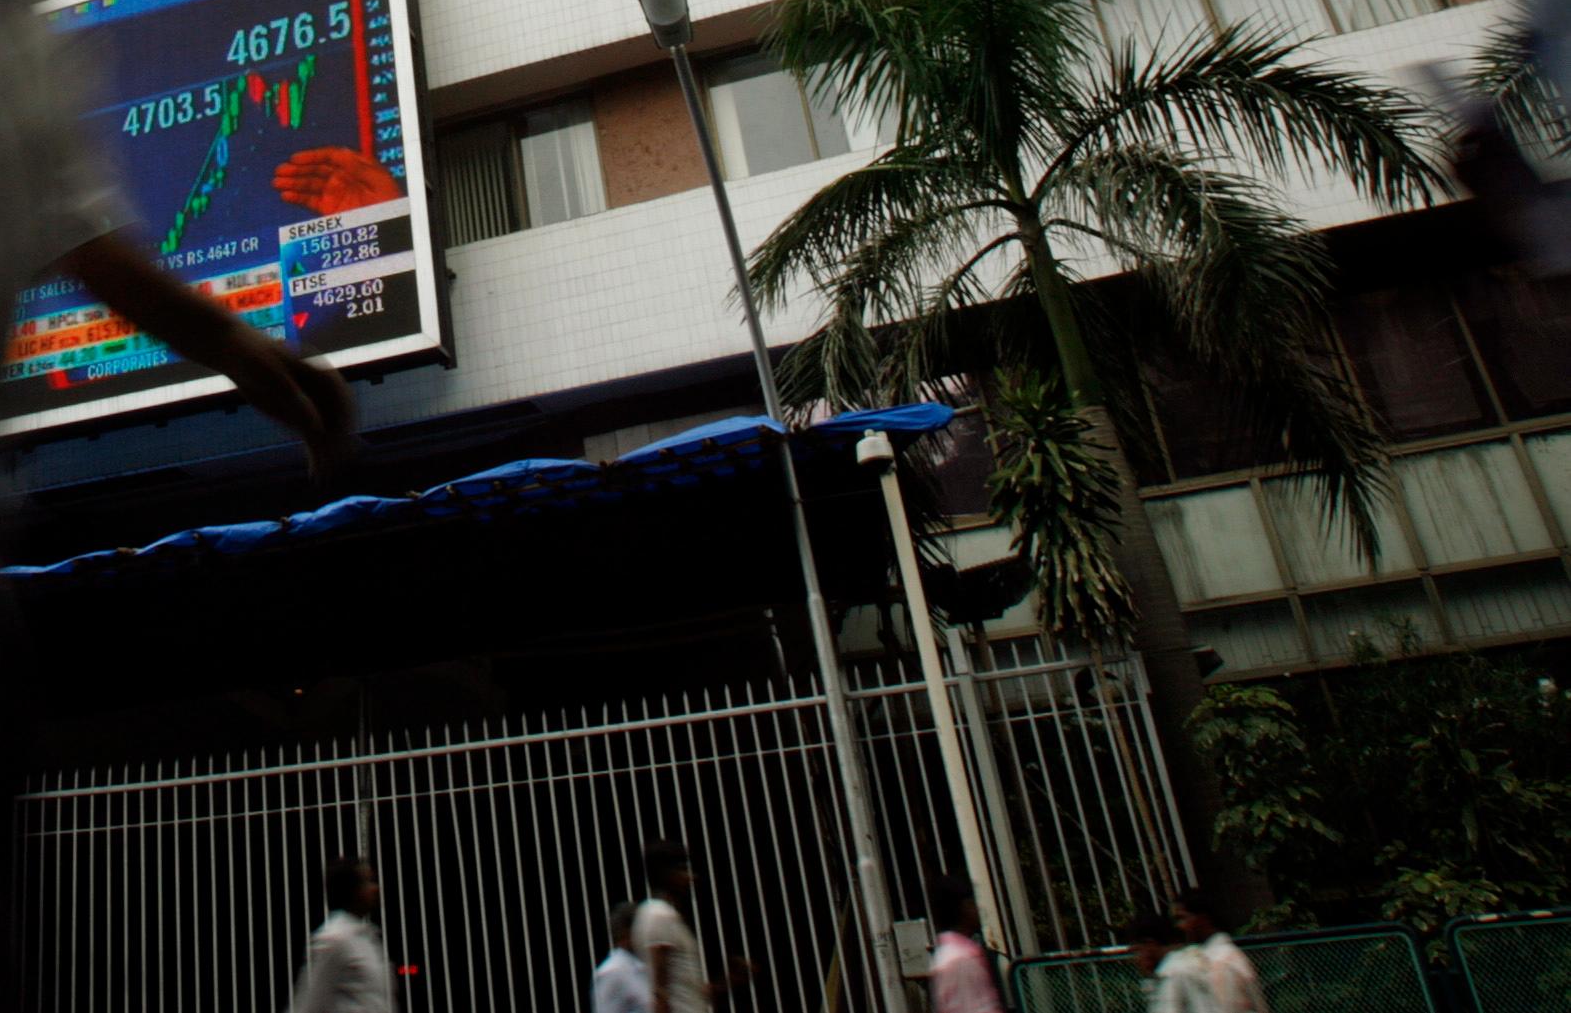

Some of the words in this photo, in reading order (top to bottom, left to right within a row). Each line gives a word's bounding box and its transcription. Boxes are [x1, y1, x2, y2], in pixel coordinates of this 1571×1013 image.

[226, 0, 351, 66] 4676.5
[122, 83, 223, 137] 4703.5
[288, 216, 343, 239] SENSEX
[301, 224, 379, 255] 15610.82
[168, 254, 183, 269] VS
[241, 236, 259, 254] CR
[321, 241, 381, 269] 222.86
[292, 273, 326, 293] FTSE
[313, 278, 384, 307] 4629.60
[346, 296, 385, 319] 2.01
[87, 349, 169, 380] CORPORATES
